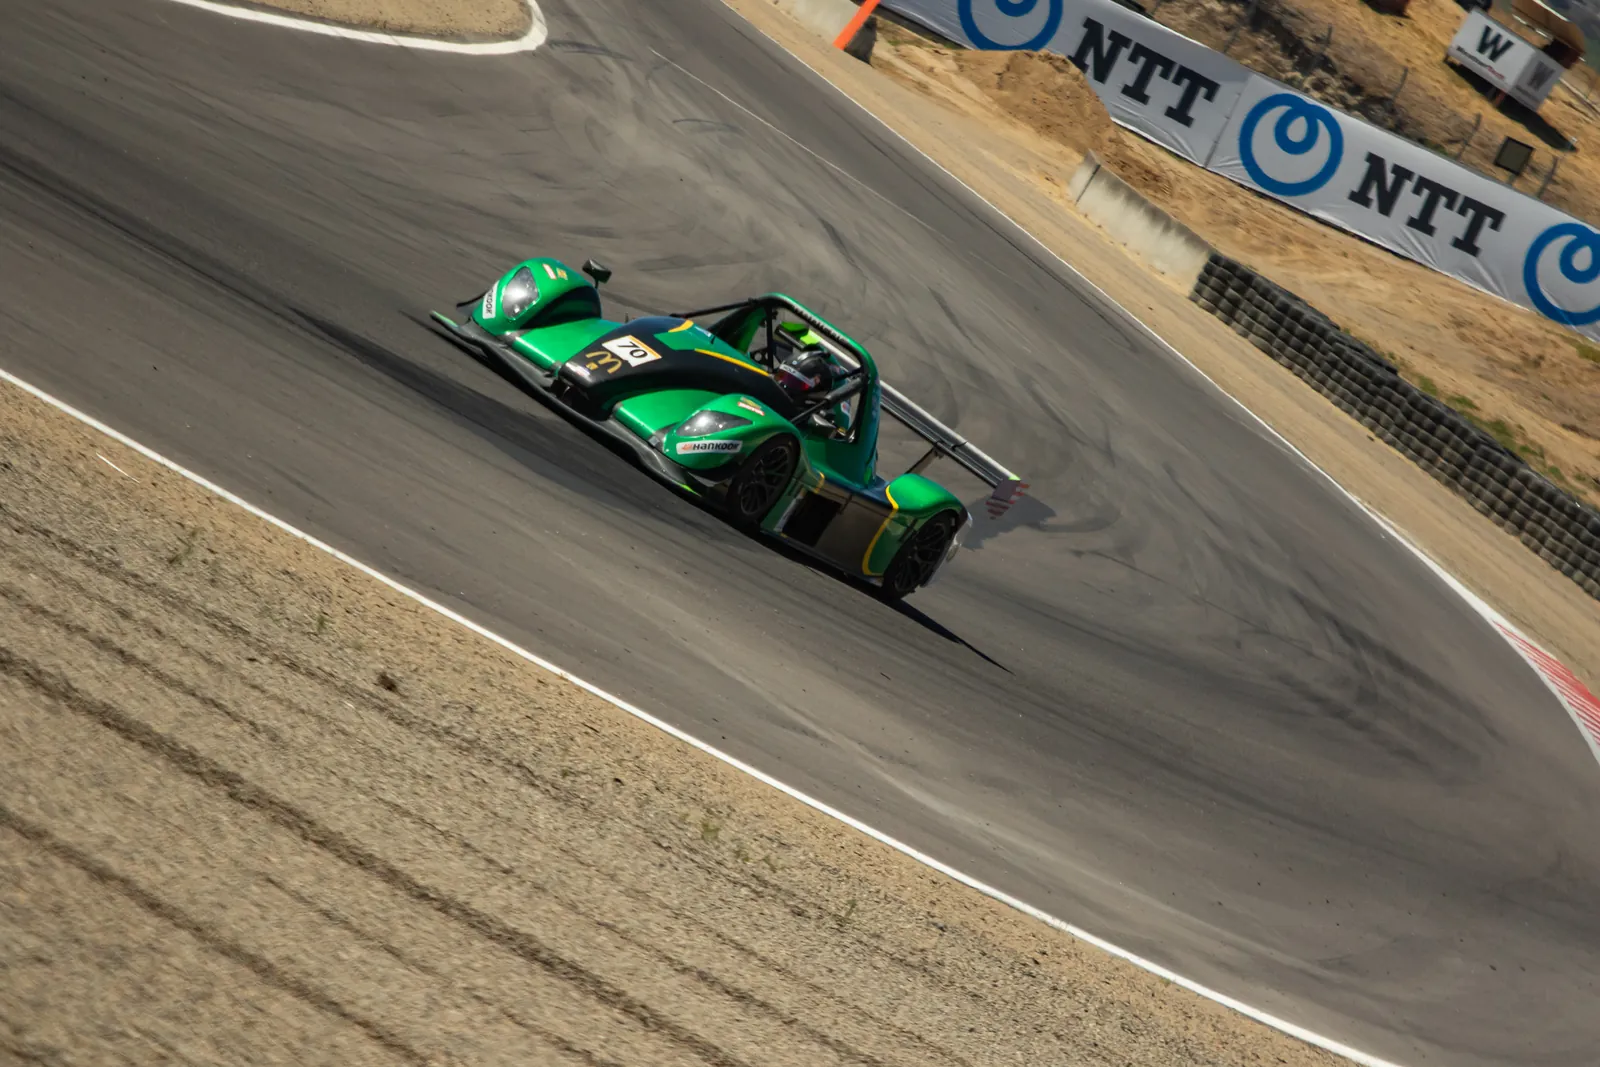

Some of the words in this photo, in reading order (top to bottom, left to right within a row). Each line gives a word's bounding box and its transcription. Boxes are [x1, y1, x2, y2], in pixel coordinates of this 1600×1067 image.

[1067, 17, 1221, 128] NTT
[1476, 24, 1514, 63] W
[1347, 151, 1507, 258] NTT
[617, 341, 648, 358] 70
